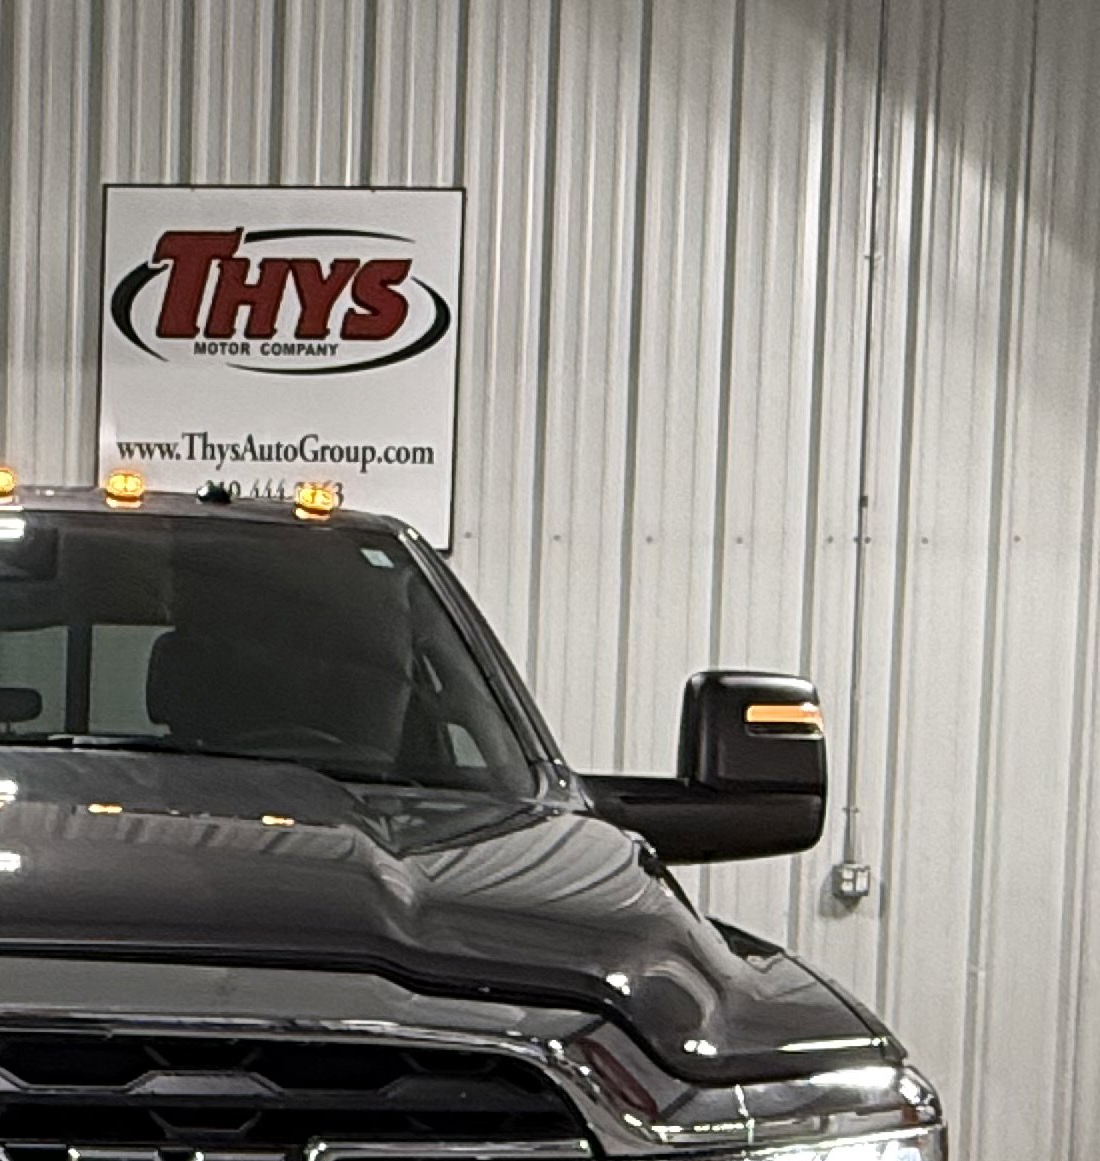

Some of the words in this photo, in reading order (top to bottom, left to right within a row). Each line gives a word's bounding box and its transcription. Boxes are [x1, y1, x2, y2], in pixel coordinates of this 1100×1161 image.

[152, 227, 413, 340] THYS
[193, 341, 251, 356] MOTOR
[259, 342, 340, 358] COMPANY
[116, 432, 436, 473] www.ThysAutoGroup.com
